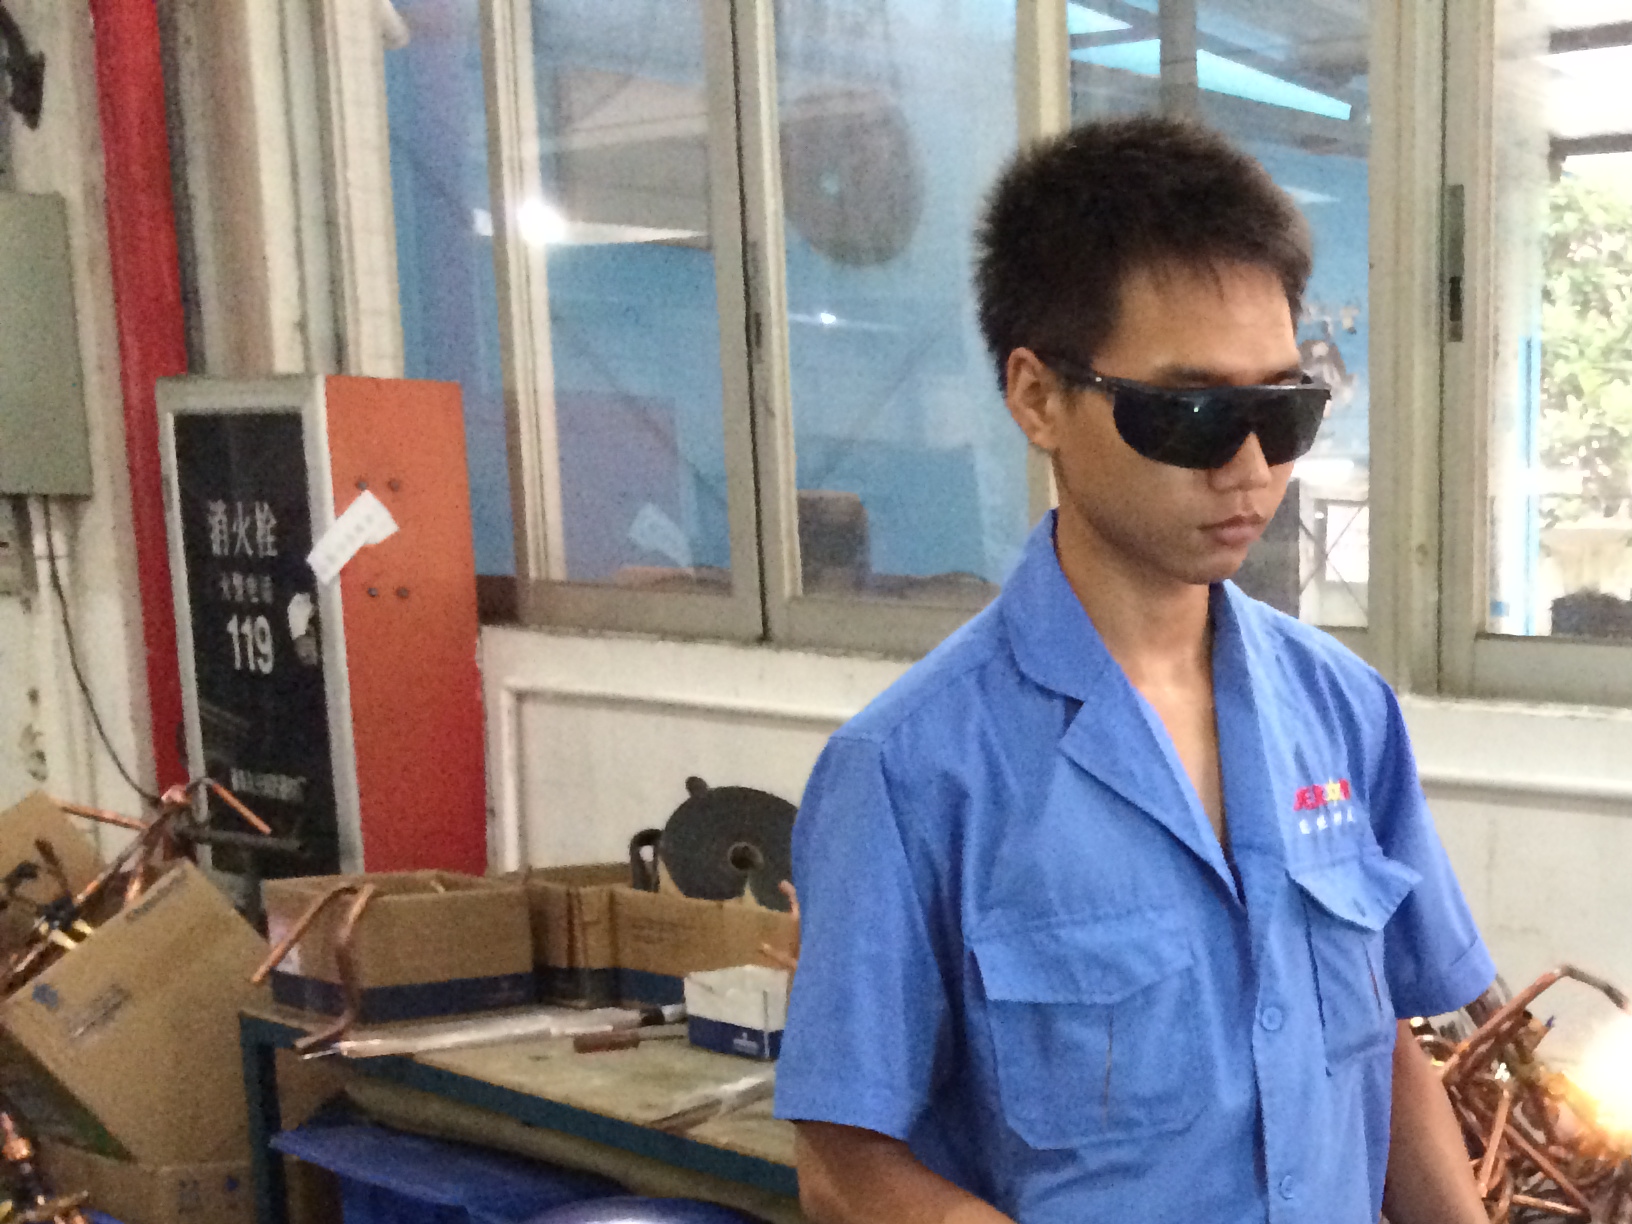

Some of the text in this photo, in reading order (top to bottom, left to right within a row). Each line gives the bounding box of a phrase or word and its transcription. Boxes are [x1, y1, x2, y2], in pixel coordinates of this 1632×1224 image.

[207, 500, 278, 558] 消火栓
[227, 615, 275, 675] 119
